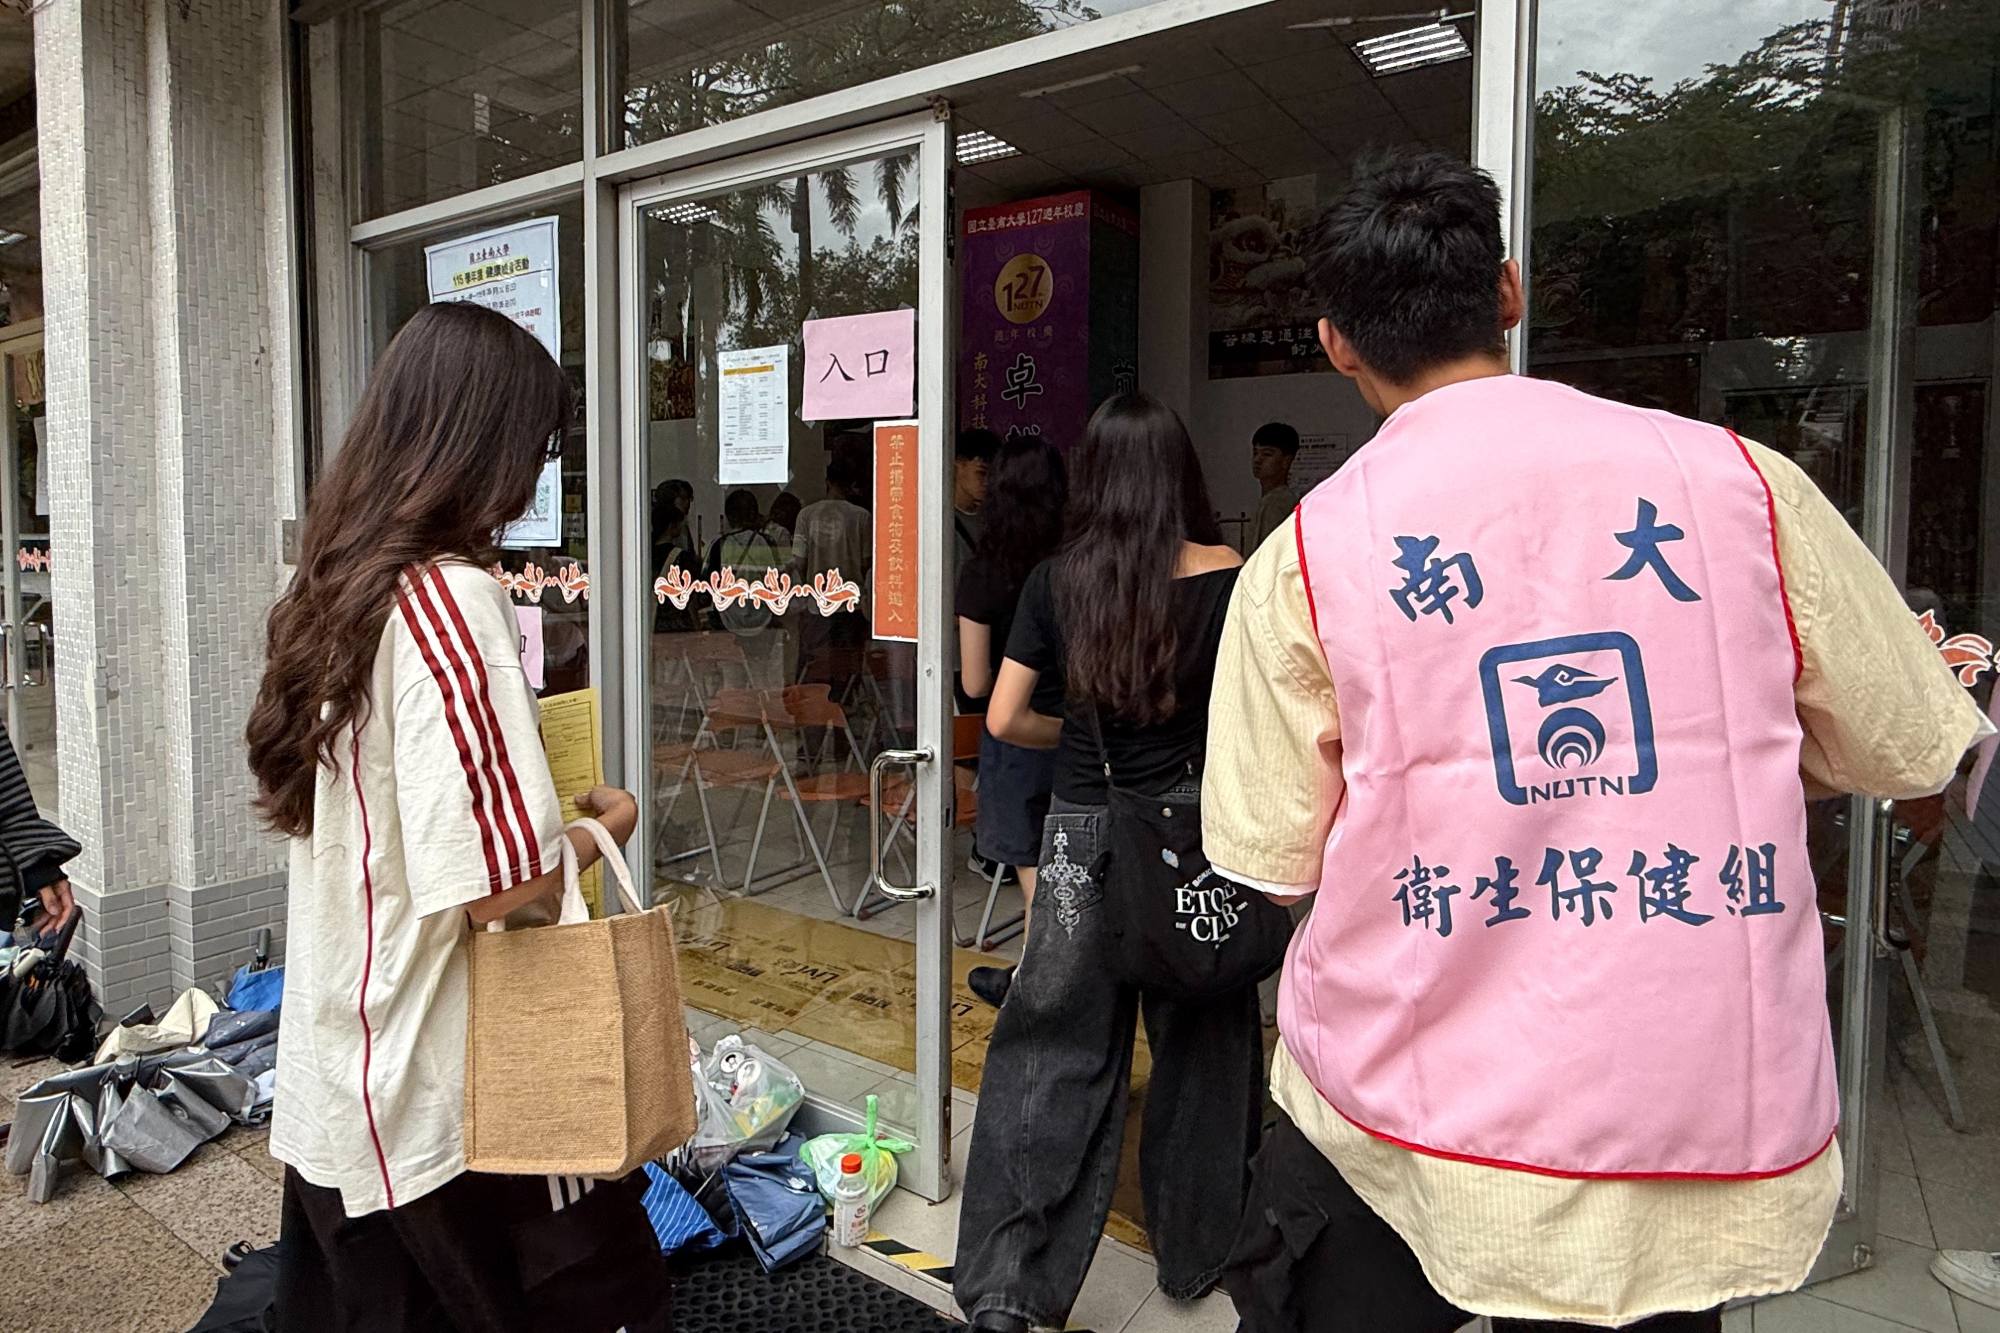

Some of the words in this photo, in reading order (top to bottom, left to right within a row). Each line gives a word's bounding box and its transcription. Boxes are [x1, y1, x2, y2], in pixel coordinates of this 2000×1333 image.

[1002, 265, 1045, 312] 127
[819, 350, 889, 383] 入口
[1530, 776, 1624, 804] NUTN
[1392, 842, 1786, 938] 衛生保健組
